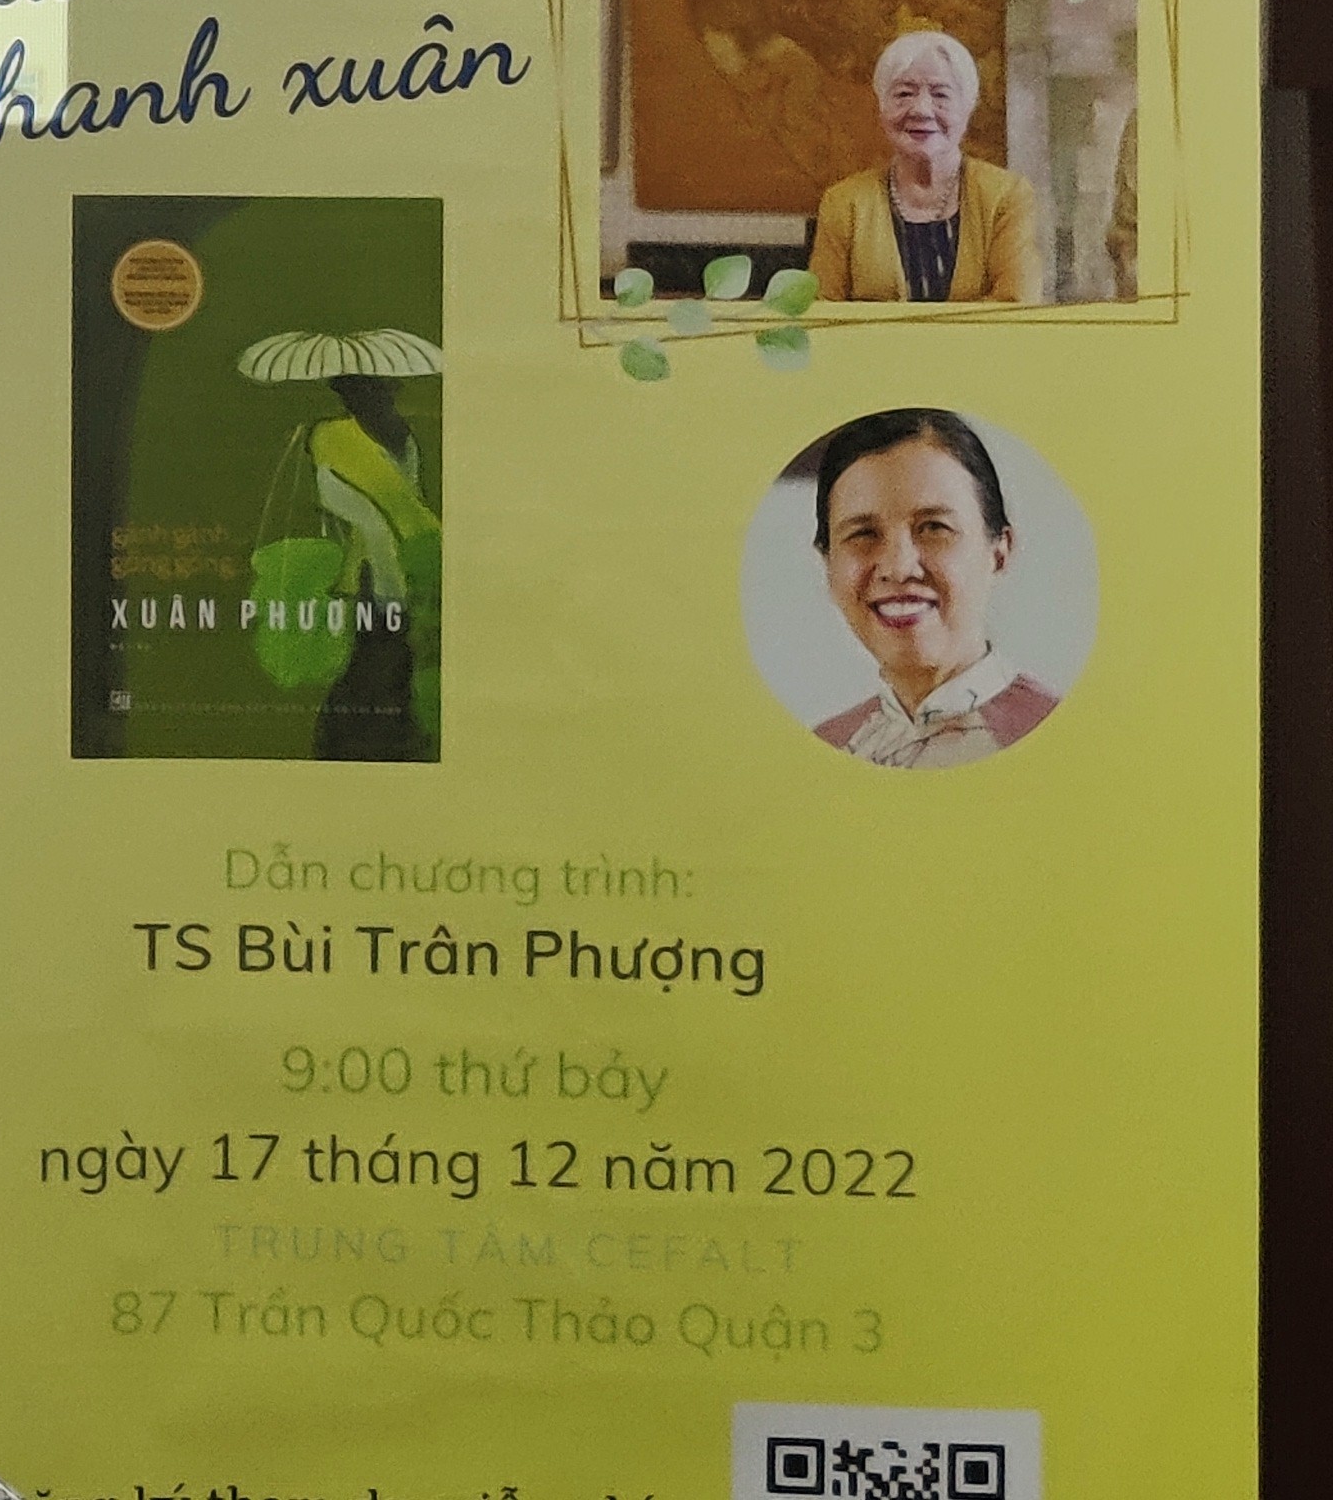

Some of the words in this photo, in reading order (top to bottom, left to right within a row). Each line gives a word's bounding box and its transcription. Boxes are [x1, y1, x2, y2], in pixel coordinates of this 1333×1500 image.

[281, 13, 531, 114] xuân
[111, 594, 216, 630] XUÂN
[240, 597, 402, 635] PHƯỢNG
[225, 842, 328, 890] Dẫn
[350, 851, 539, 906] chương
[563, 853, 694, 898] trình:
[134, 922, 212, 972] TS
[238, 921, 331, 973] Bùi
[355, 924, 498, 976] Trân
[526, 929, 767, 997] Phượng
[281, 1044, 413, 1095] 9:00
[434, 1046, 538, 1097] thứ
[558, 1048, 668, 1114] bảy
[38, 1129, 184, 1194] ngày
[209, 1133, 280, 1182] 17
[303, 1135, 481, 1200] tháng
[509, 1139, 580, 1189] 12
[604, 1143, 735, 1194] năm
[762, 1147, 917, 1199] 2022
[213, 1223, 411, 1265] TRUNG
[439, 1221, 558, 1268] TÂM
[585, 1231, 804, 1274] CEFALT
[110, 1290, 176, 1337] 87
[199, 1285, 327, 1340] Trần
[348, 1289, 495, 1342] Quốc
[514, 1295, 656, 1347] Thảo
[677, 1300, 829, 1362] Quận
[852, 1308, 884, 1354] 3
